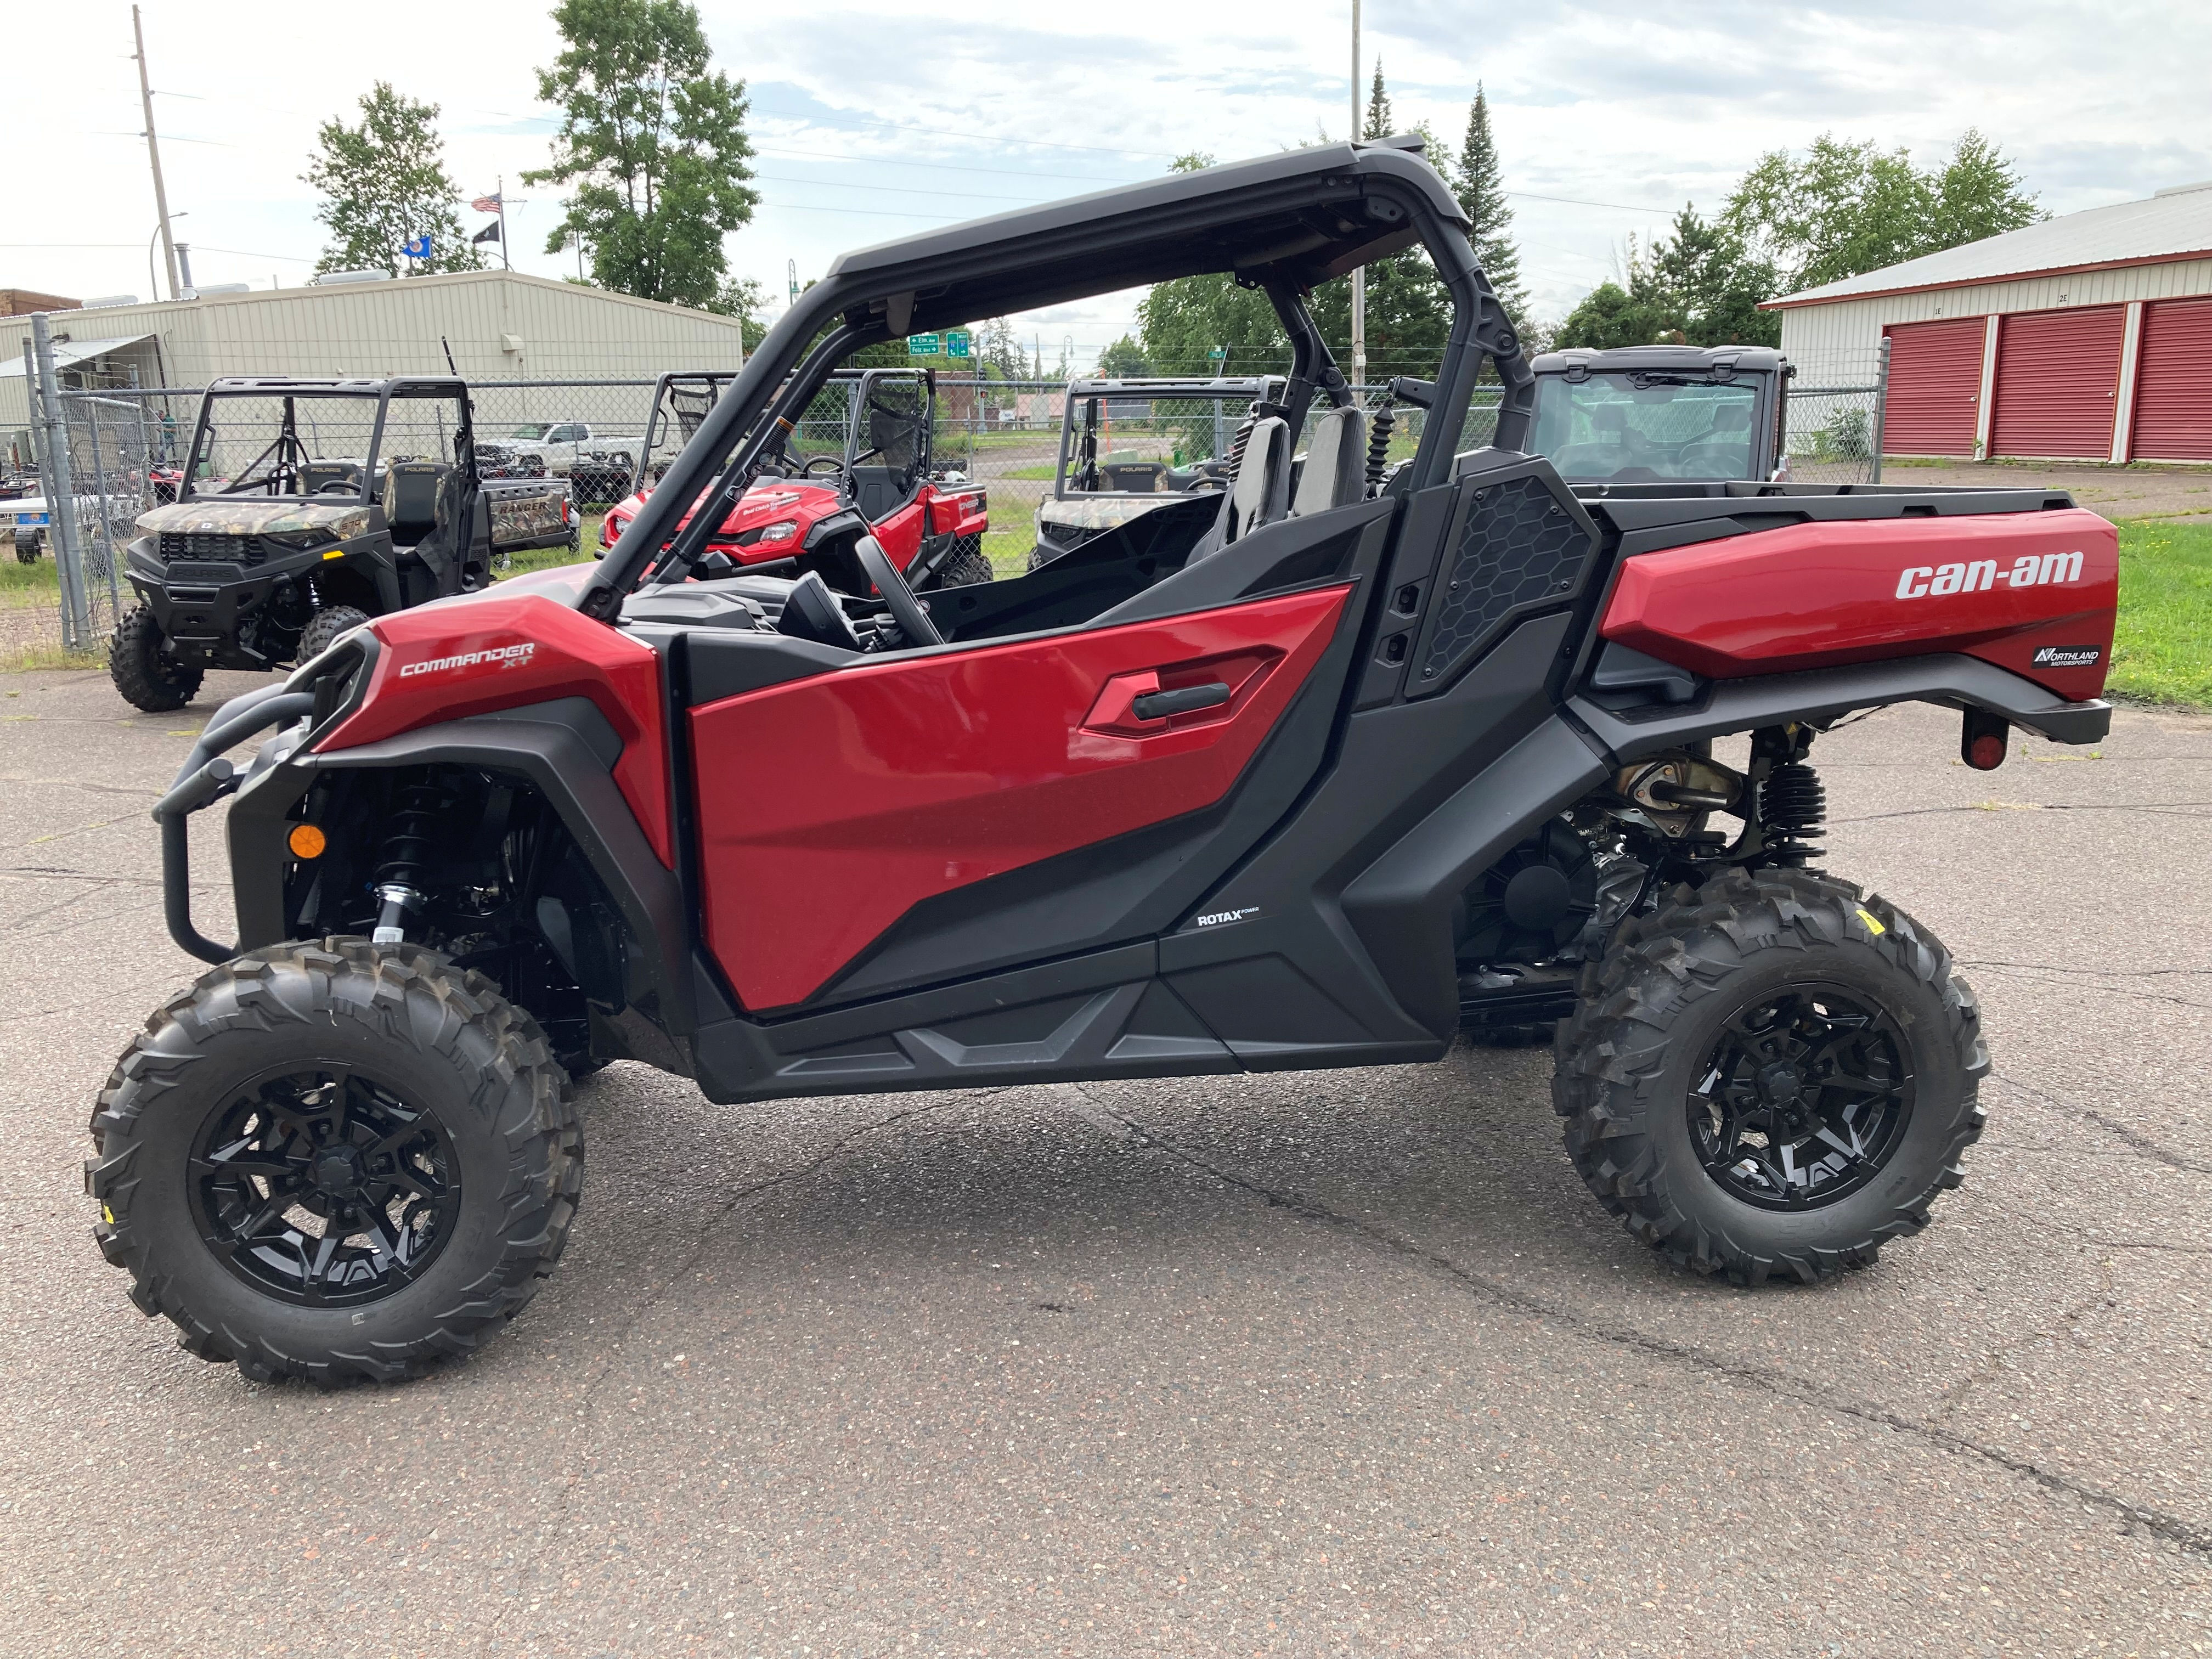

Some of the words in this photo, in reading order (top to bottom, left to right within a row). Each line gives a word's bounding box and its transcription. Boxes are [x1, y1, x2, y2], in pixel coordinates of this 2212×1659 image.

[2059, 294, 2068, 302] 2E
[500, 501, 548, 514] RANGER
[341, 518, 362, 531] 570
[1895, 551, 2084, 600] can-am
[400, 642, 535, 678] COMMANDER
[2034, 647, 2099, 662] NORTHLAND
[501, 655, 533, 669] XT
[1198, 910, 1243, 926] ROTAX
